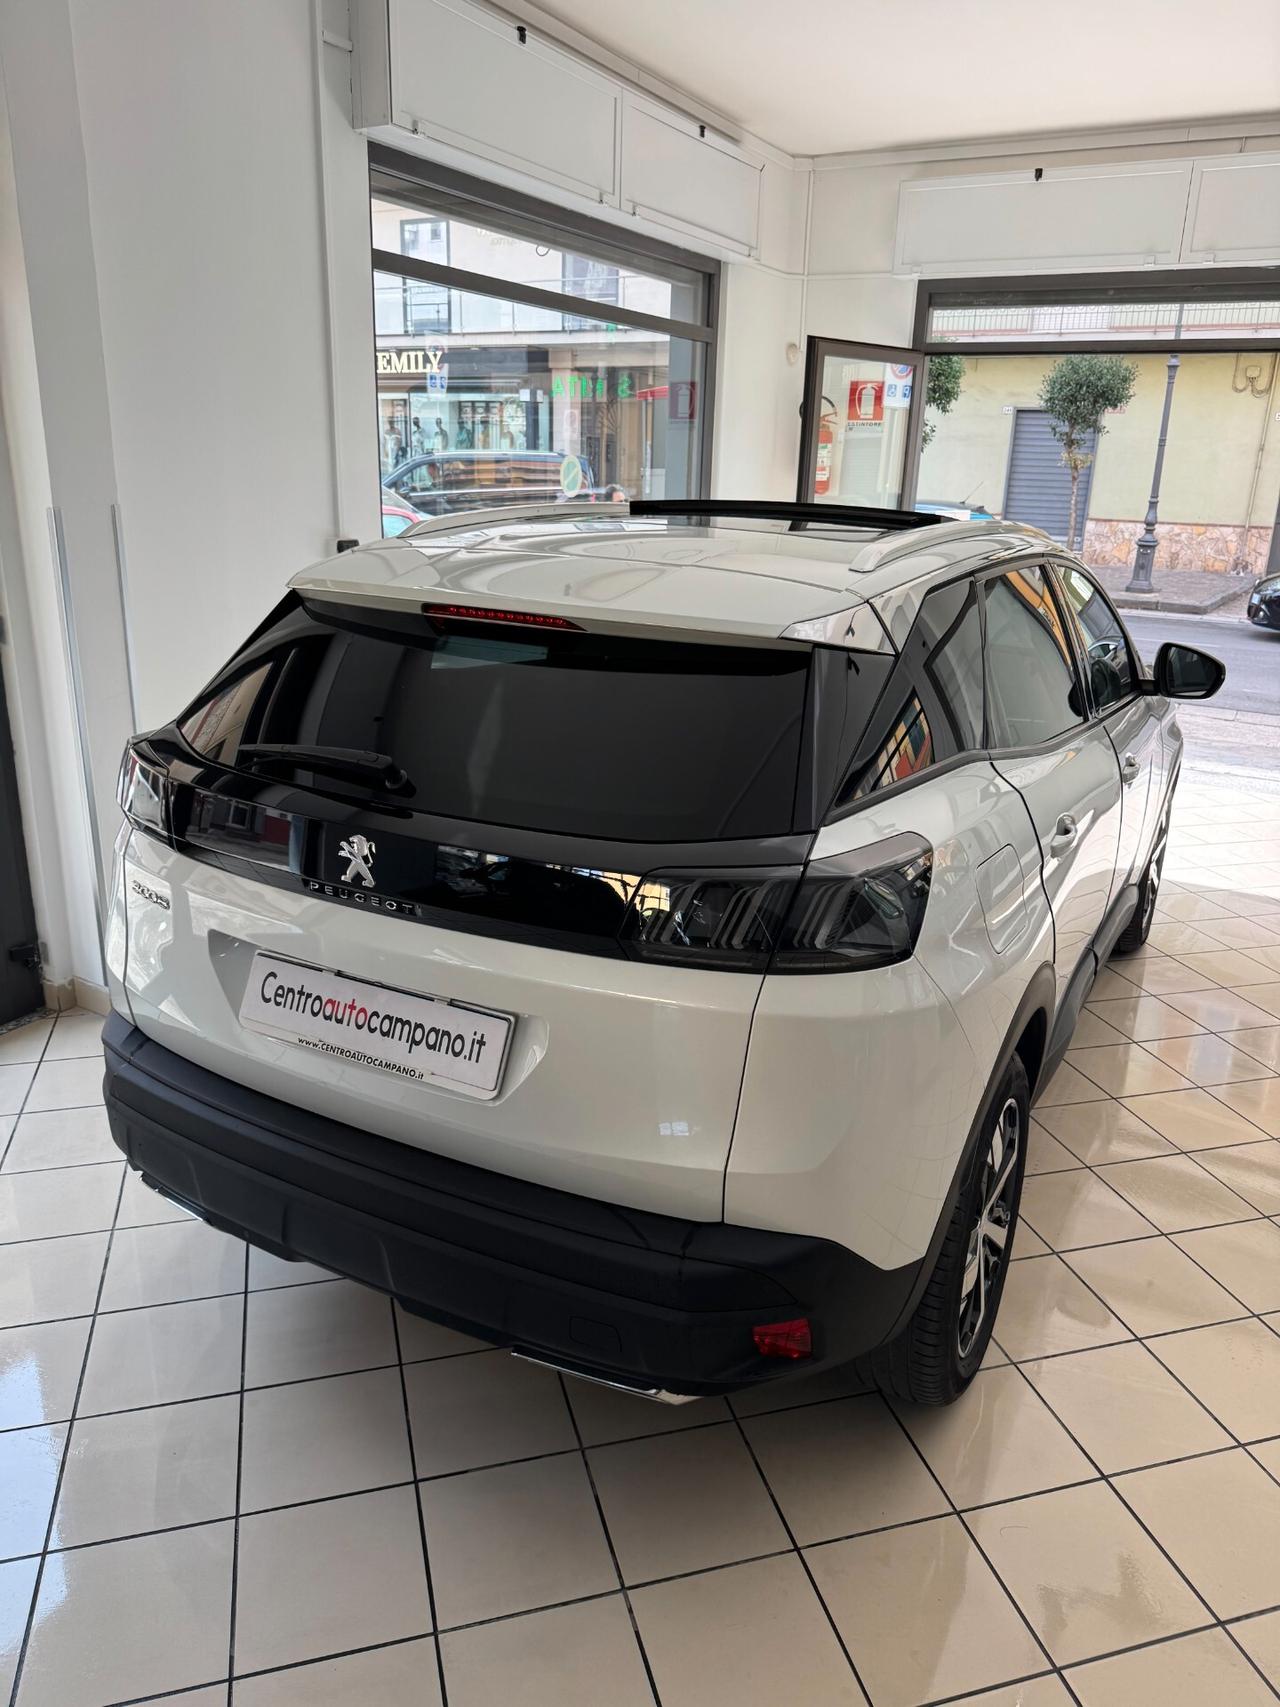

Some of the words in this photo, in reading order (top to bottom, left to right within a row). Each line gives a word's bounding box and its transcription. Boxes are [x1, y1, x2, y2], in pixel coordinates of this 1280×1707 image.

[376, 351, 442, 374] EMILY
[132, 879, 171, 911] 3008
[309, 881, 413, 914] PEUGEOT
[260, 970, 487, 1064] Centroautocampano.it
[297, 1036, 424, 1080] www.CENTROAUTOCAMPANO.it
